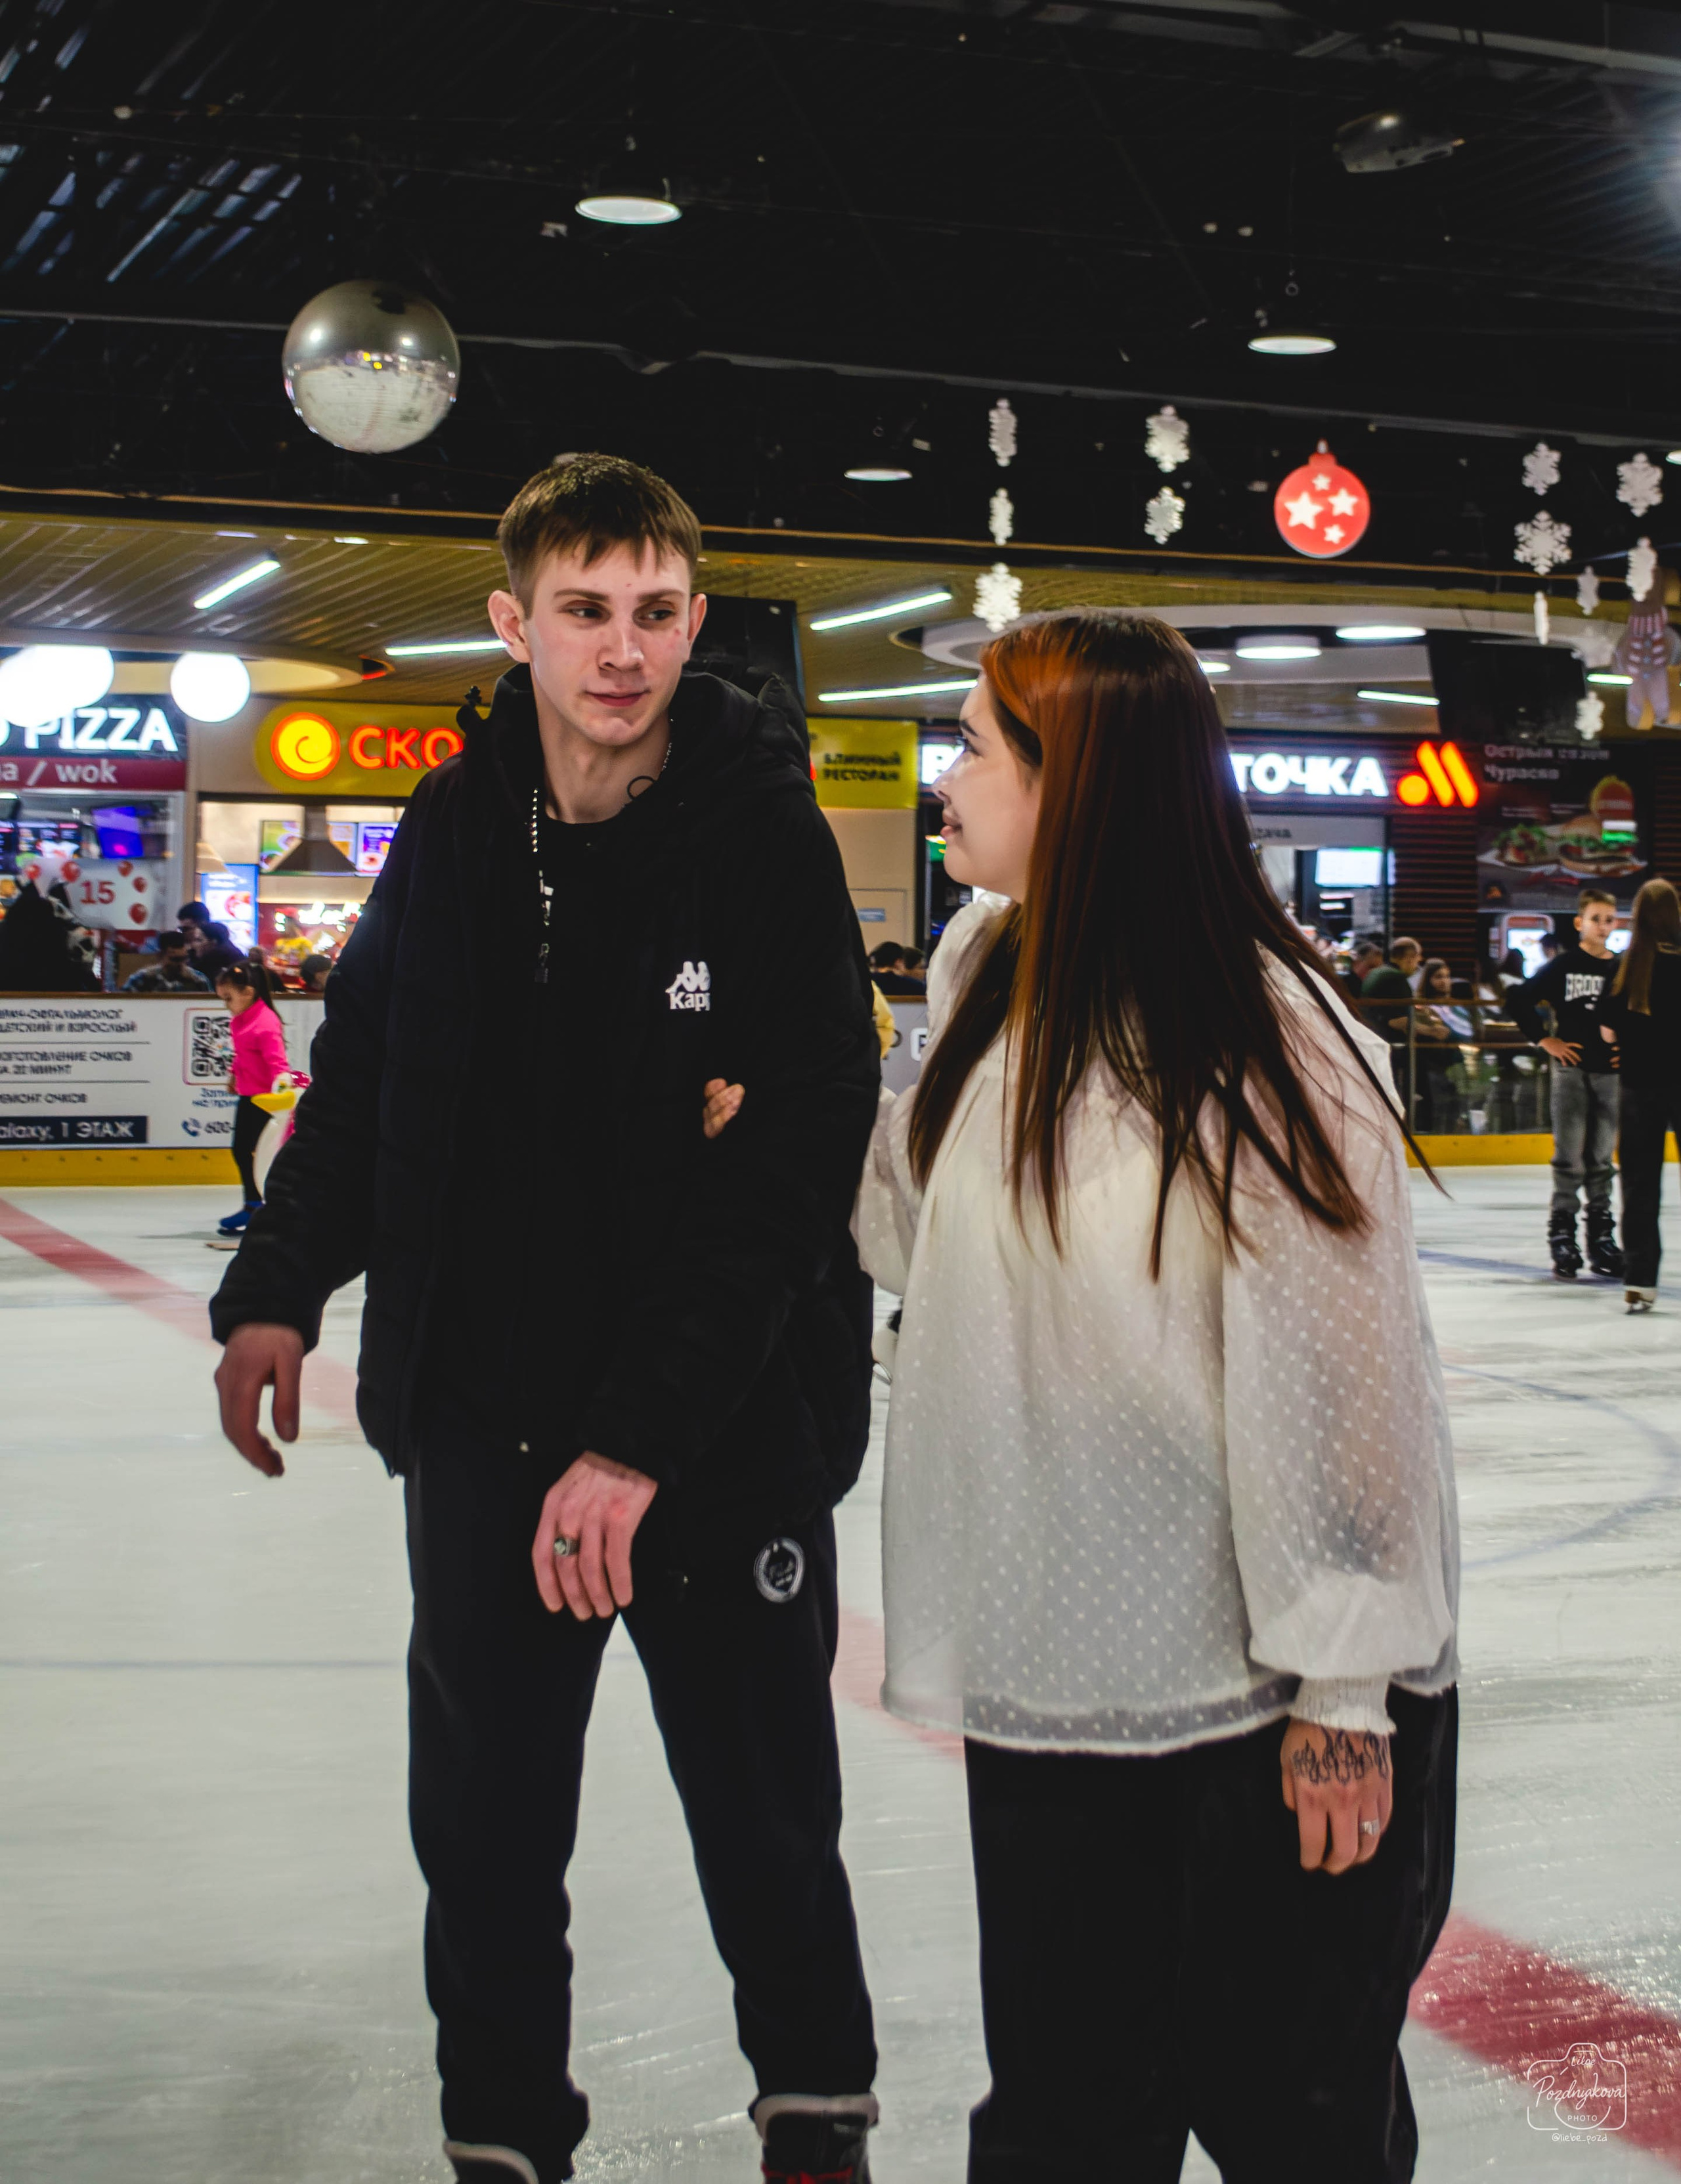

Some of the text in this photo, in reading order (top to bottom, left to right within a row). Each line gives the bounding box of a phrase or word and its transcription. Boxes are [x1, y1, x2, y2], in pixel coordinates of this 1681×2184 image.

[24, 707, 179, 752] PIZZA
[348, 724, 464, 770] СКО
[55, 758, 118, 783] wok
[1228, 752, 1389, 797] ТОЧКА
[80, 881, 116, 905] 15
[76, 1122, 134, 1138] ЭТАЖ
